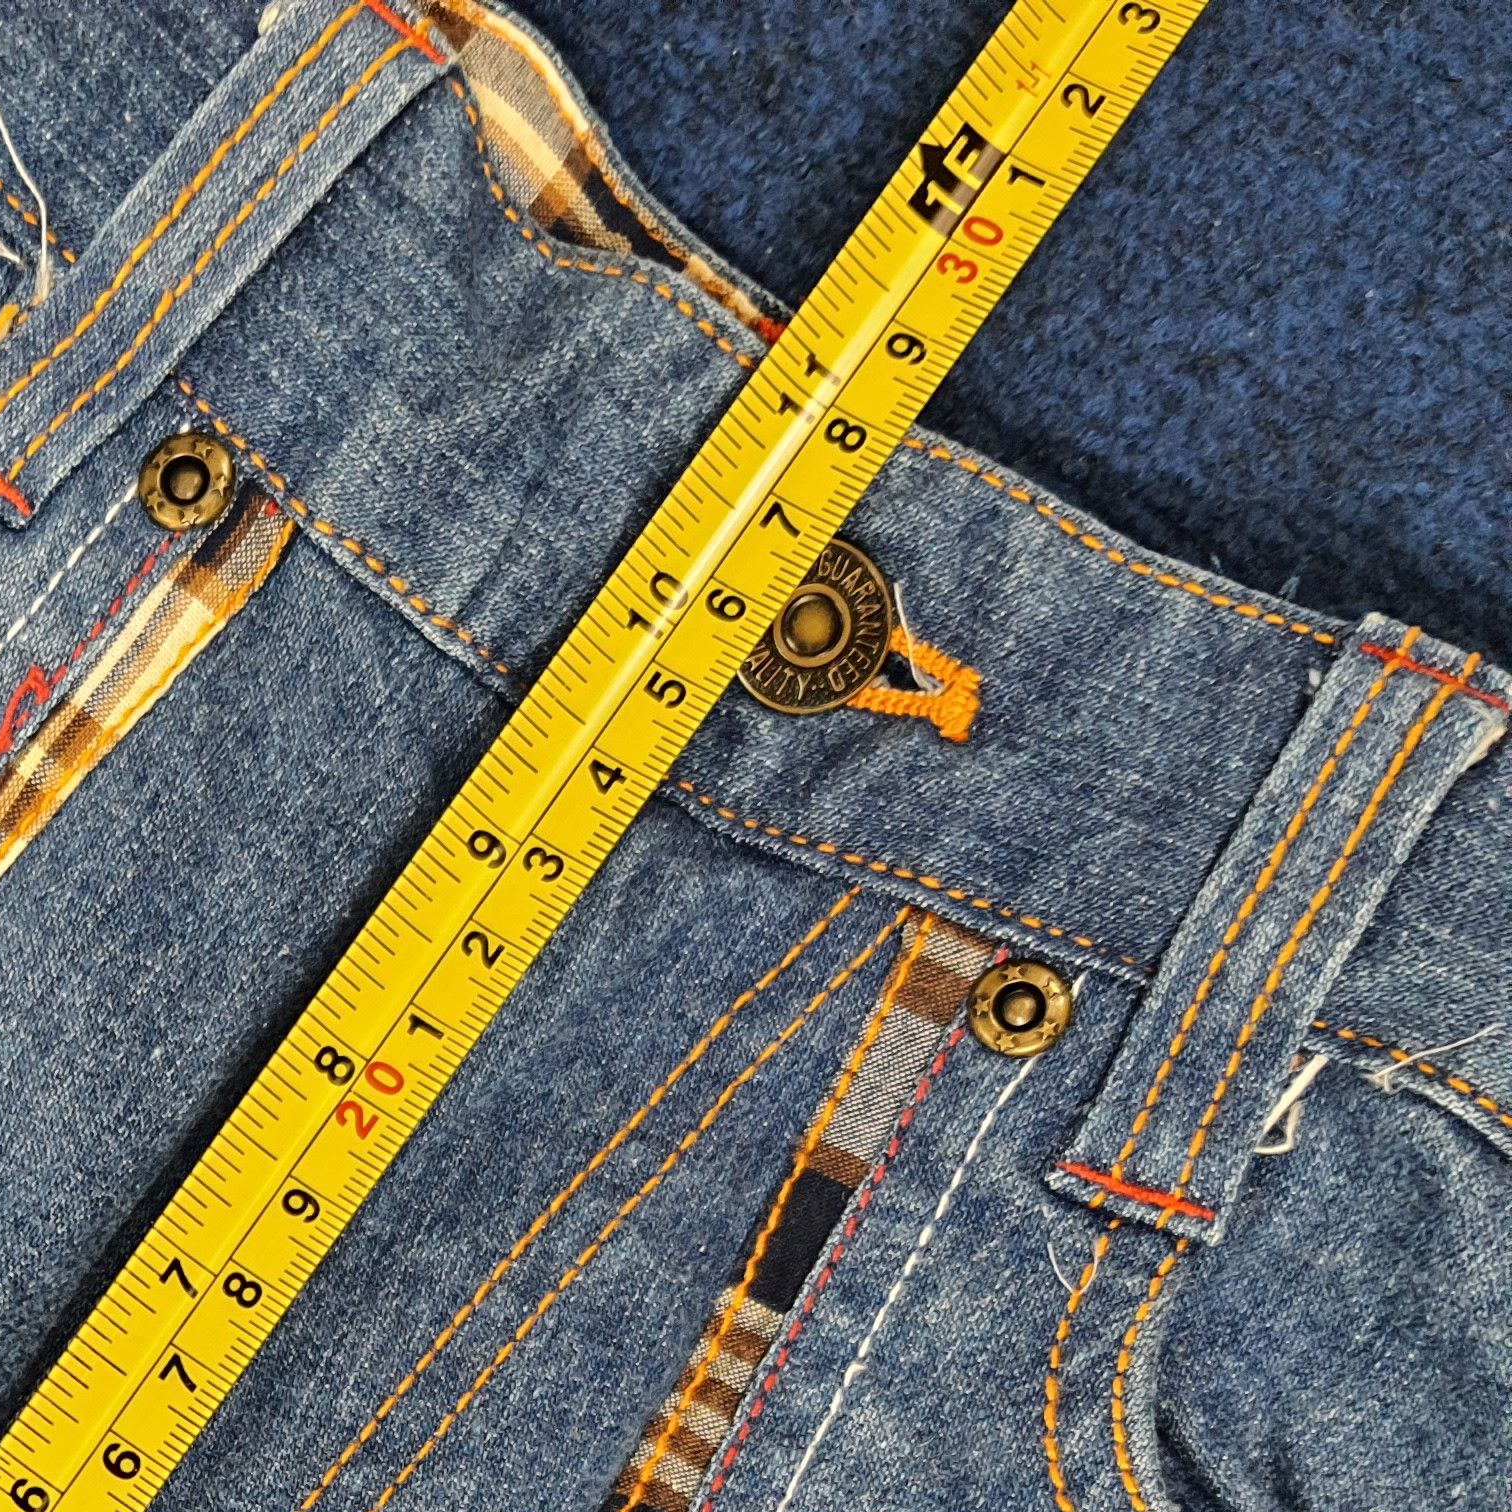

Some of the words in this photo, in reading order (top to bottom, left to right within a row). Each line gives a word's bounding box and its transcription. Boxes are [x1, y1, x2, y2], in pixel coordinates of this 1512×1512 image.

[1118, 1, 1162, 33] 3
[1060, 82, 1107, 119] 2
[924, 134, 984, 217] 1F
[1006, 164, 1047, 189] 1
[937, 215, 1005, 285] 30
[886, 332, 928, 365] 9
[775, 352, 842, 425] 11
[823, 417, 868, 454] 8
[760, 501, 802, 538] 7
[626, 571, 690, 640] 10
[705, 588, 747, 622] 6
[644, 670, 688, 709] 5
[744, 643, 813, 702] ALITY
[588, 758, 628, 795] 4
[467, 828, 508, 869] 9
[522, 845, 566, 882] 3
[461, 930, 506, 970] 2
[407, 1012, 446, 1041] 1
[313, 1044, 356, 1087] 8
[334, 1060, 406, 1140] 20
[281, 1187, 322, 1224] 9
[159, 1257, 200, 1300] 7
[221, 1271, 264, 1310] 8
[158, 1353, 198, 1394] 7
[101, 1442, 142, 1481] 6
